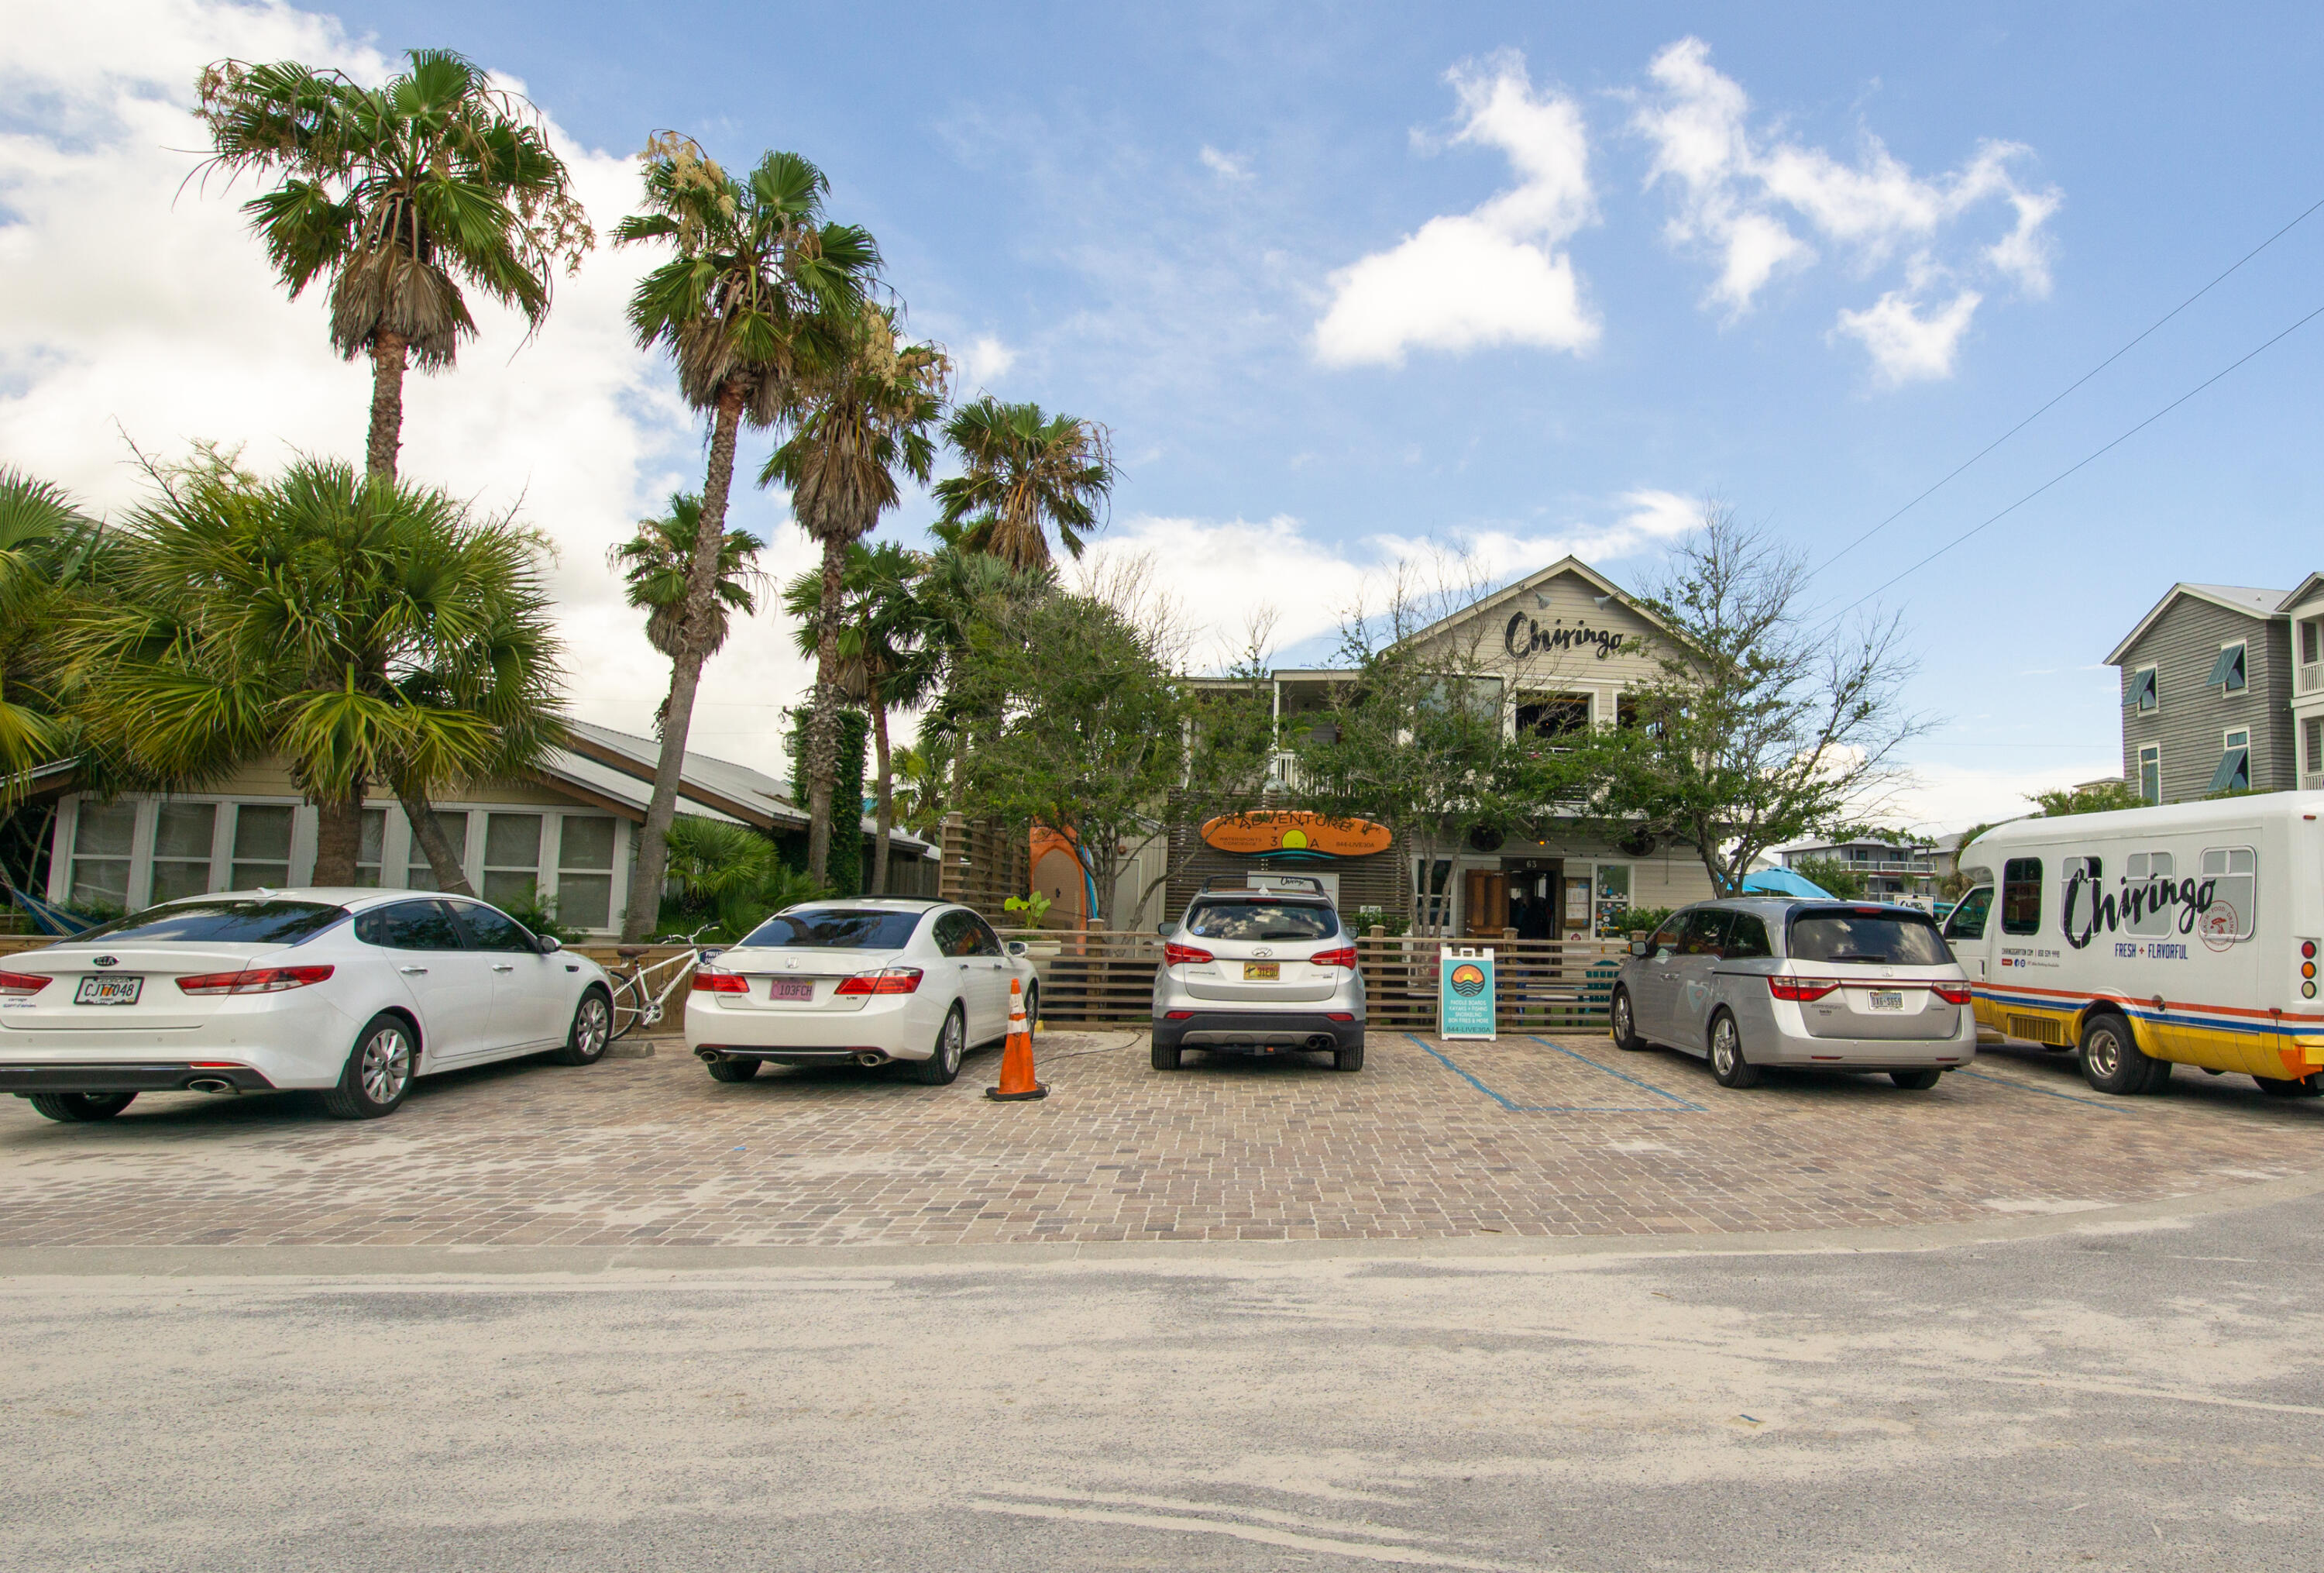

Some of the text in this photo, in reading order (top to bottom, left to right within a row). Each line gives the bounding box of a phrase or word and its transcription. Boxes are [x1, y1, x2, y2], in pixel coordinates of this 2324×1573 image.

[1505, 611, 1624, 659] Chiringo
[2064, 868, 2216, 949] Chiringo
[2115, 942, 2137, 958] FRESH
[2148, 943, 2188, 959] FLAVORFUL
[95, 956, 115, 965] KIA
[84, 983, 135, 996] CJT7048
[779, 985, 813, 996] 103FCH
